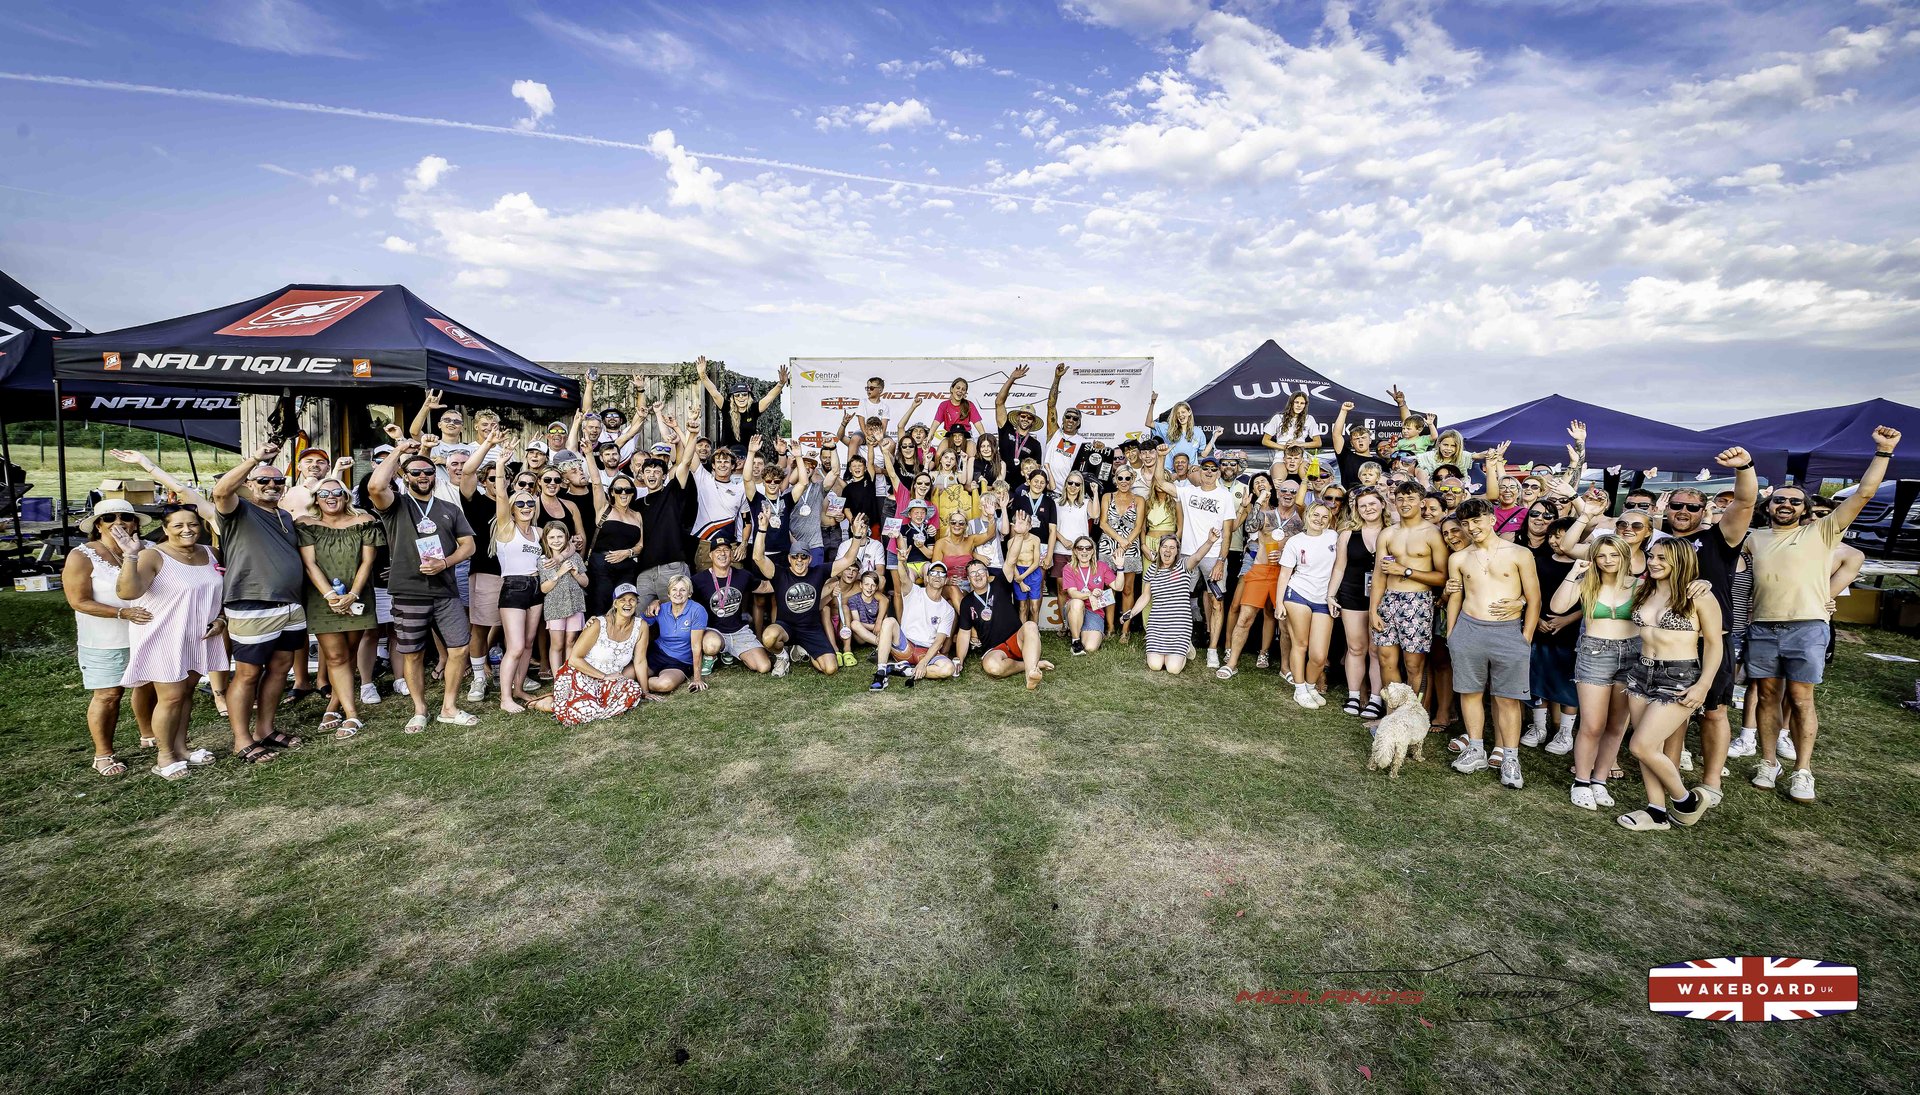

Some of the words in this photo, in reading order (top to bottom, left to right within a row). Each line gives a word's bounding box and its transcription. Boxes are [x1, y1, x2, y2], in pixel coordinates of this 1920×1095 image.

[132, 352, 339, 375] NAUTIQUE
[465, 369, 557, 395] NAUTIQUE
[815, 371, 840, 379] central
[90, 396, 241, 410] NAUTIQU
[880, 391, 968, 400] MIDLAND
[1047, 600, 1063, 625] 3
